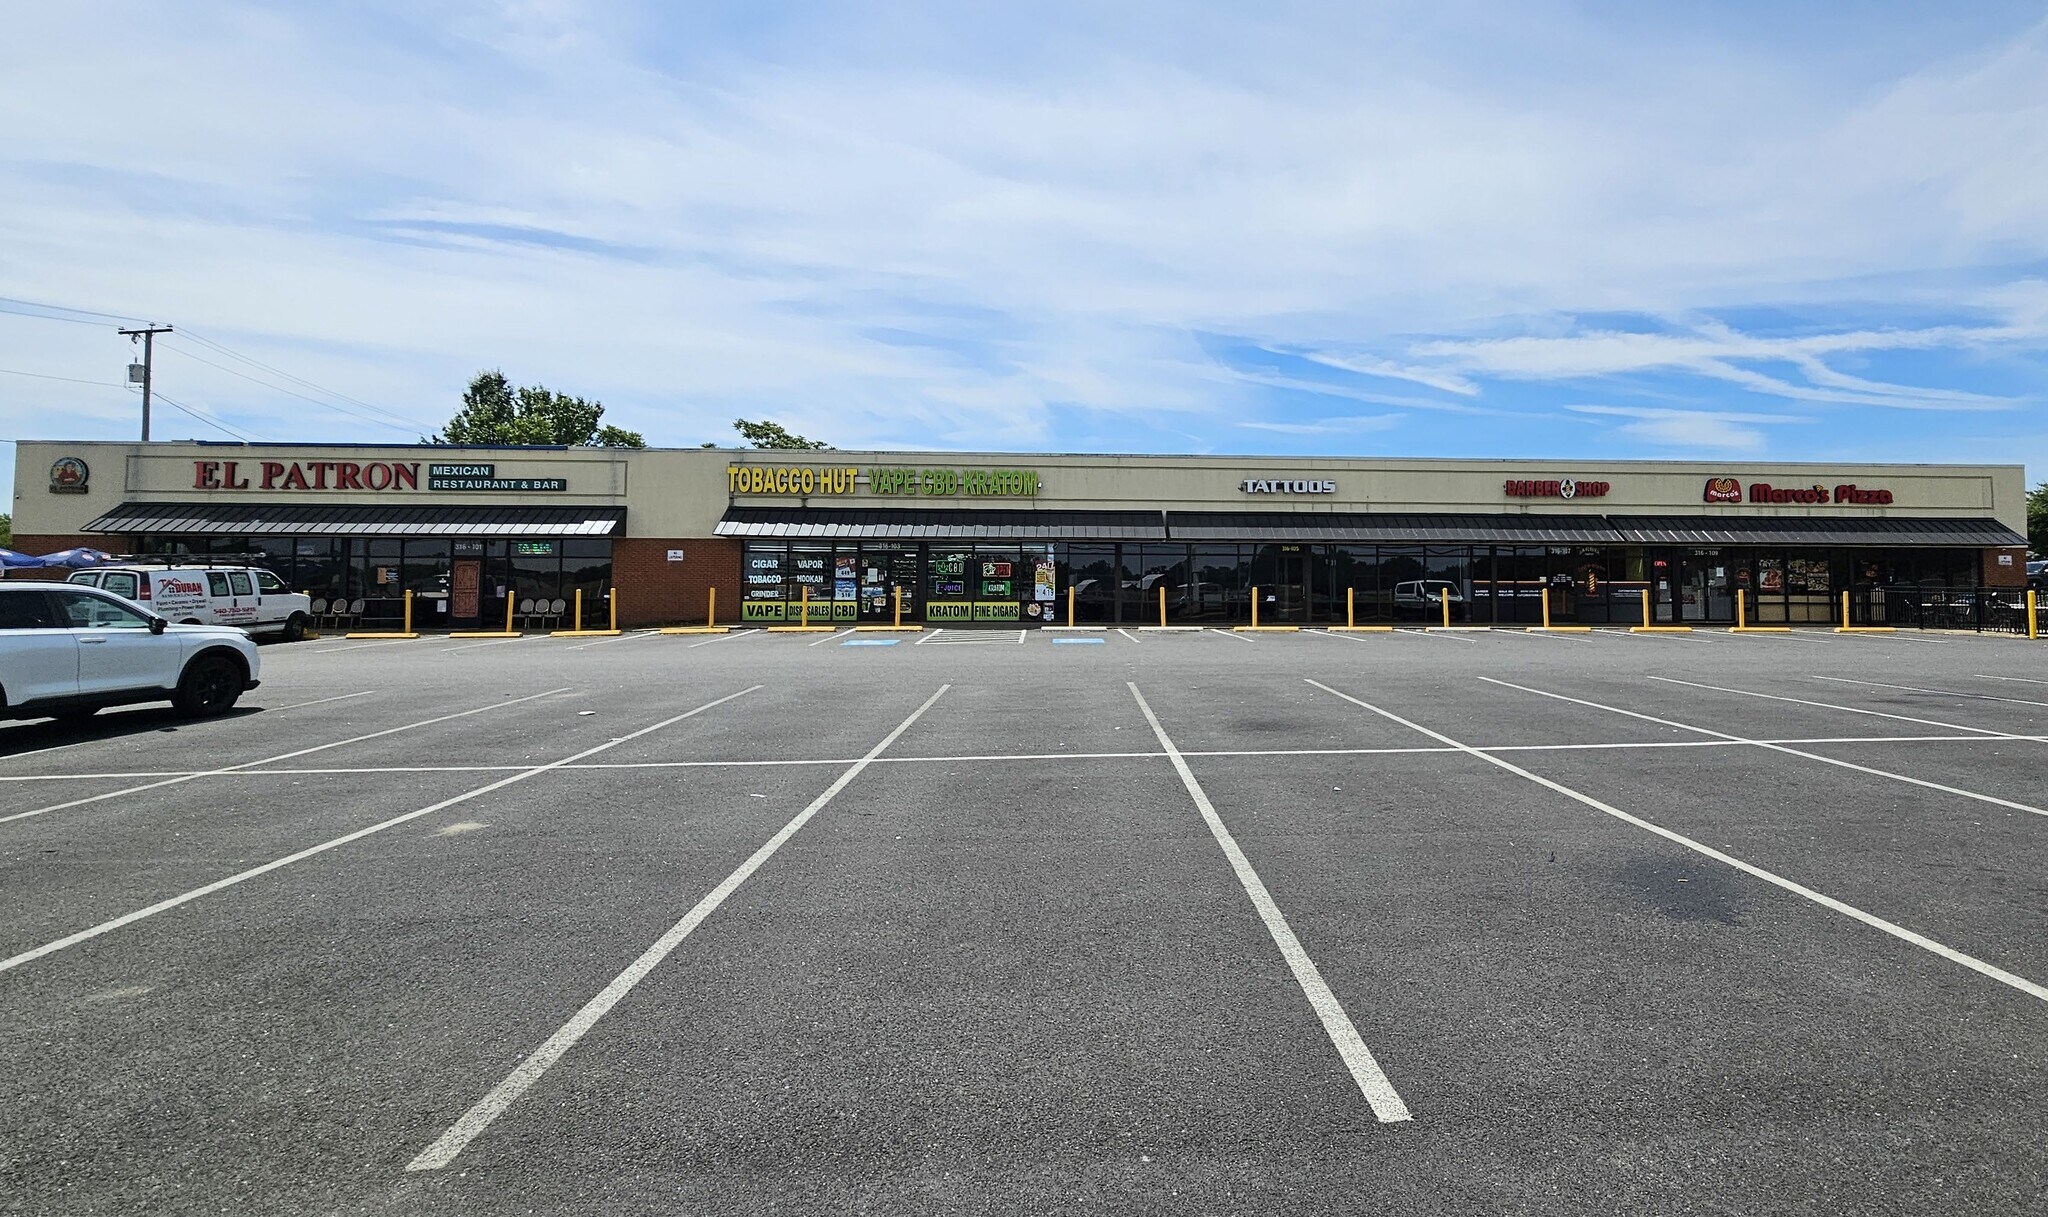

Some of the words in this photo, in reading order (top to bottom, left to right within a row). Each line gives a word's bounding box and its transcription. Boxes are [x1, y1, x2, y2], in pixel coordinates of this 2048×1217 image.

[193, 462, 249, 490] EL
[259, 462, 420, 491] PATRON
[433, 466, 489, 476] MEXICAN
[433, 480, 516, 489] RESTAURANT
[521, 480, 528, 489] &
[533, 480, 559, 489] BAR
[727, 467, 814, 494] TOBACCO
[820, 468, 858, 494] HUT
[868, 468, 915, 494] VAPE
[921, 469, 958, 495] CBD
[963, 470, 1038, 496] KRATOM
[1244, 480, 1336, 493] TATTOOS
[1506, 480, 1560, 496] BARBER
[1575, 481, 1610, 497] SHOP
[1750, 484, 1830, 503] Marco's
[1835, 484, 1893, 504] Pizza
[752, 560, 779, 569] CIGAR
[797, 560, 824, 569] VAPOR
[948, 563, 963, 573] CBD
[749, 575, 781, 584] TOBACCO
[797, 575, 823, 583] HOOKAH
[175, 582, 203, 593] DURAN
[751, 590, 779, 598] GRINDER
[747, 605, 782, 617] VAPE
[789, 605, 829, 617] DISPSABLES
[835, 605, 855, 617] CBD
[929, 605, 969, 617] KRATOM
[975, 605, 991, 617] FINE
[992, 605, 1019, 618] CIGARS
